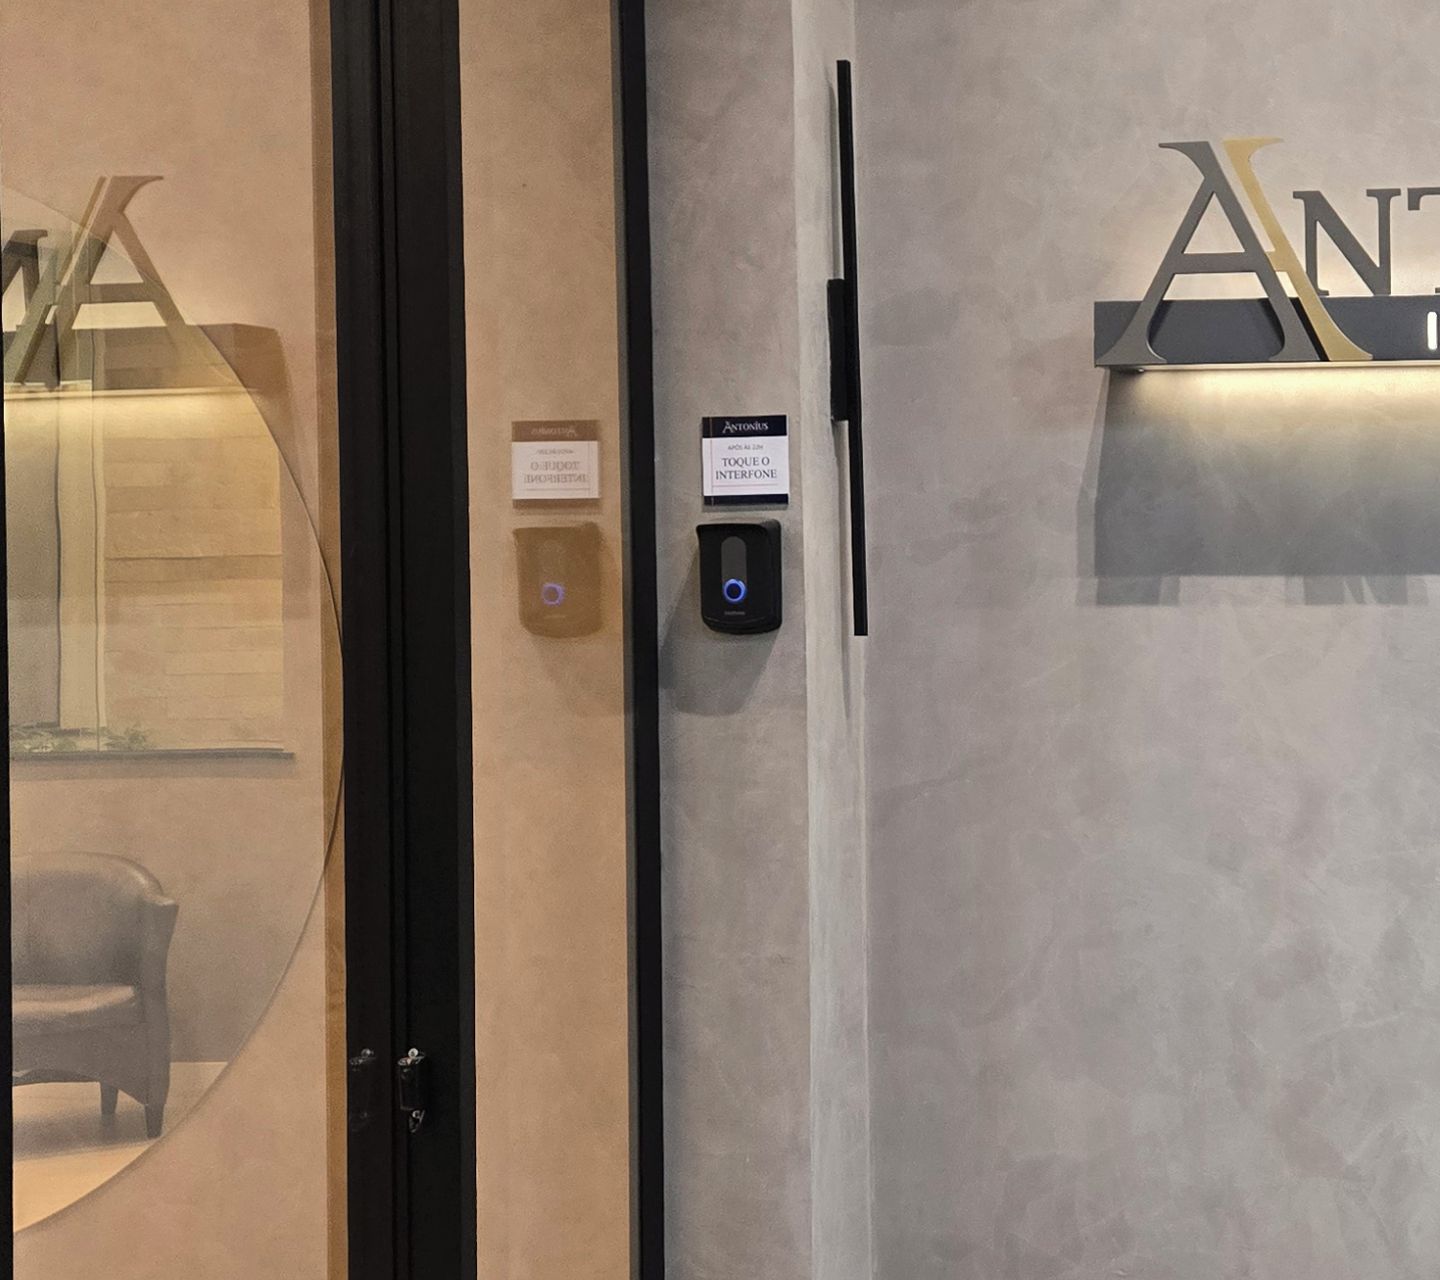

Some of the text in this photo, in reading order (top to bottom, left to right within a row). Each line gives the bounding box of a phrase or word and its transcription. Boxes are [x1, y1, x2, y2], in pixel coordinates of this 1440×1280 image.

[722, 421, 769, 433] ANTONIUS
[721, 457, 770, 467] TOQUE O
[715, 470, 776, 480] INTERFONE
